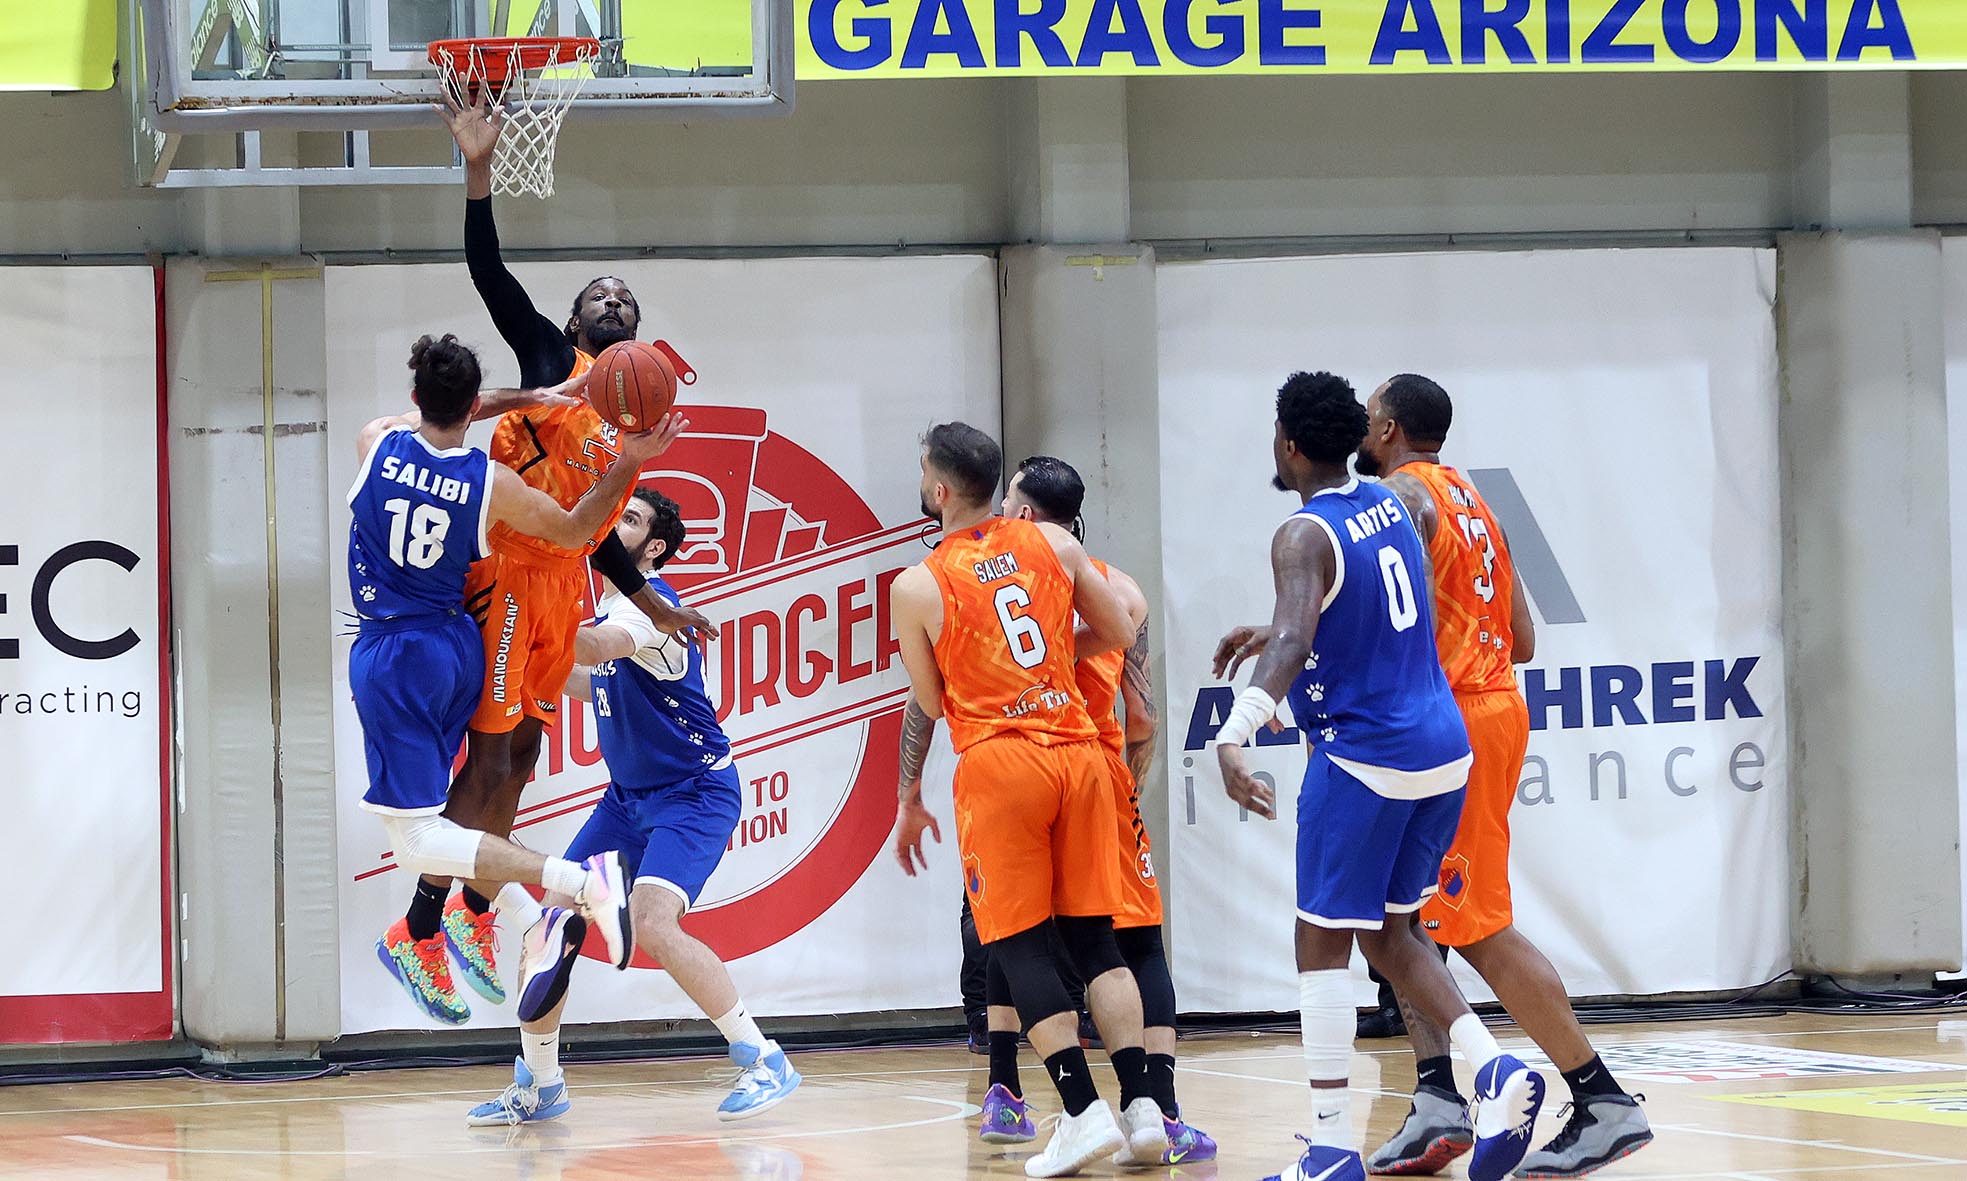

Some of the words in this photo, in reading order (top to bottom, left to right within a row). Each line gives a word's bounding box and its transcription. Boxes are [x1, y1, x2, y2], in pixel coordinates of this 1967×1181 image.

[808, 0, 1327, 71] GARAGE
[1369, 0, 1917, 65] ARIZONA
[380, 456, 471, 505] SALIBI
[384, 497, 451, 570] 18
[1344, 497, 1403, 544] ARTIS
[0, 540, 142, 660] C
[973, 551, 1020, 584] SALEM
[1378, 544, 1419, 633] 0
[493, 604, 519, 703] MANOUKIAN
[993, 582, 1048, 670] 6
[750, 771, 789, 808] TO
